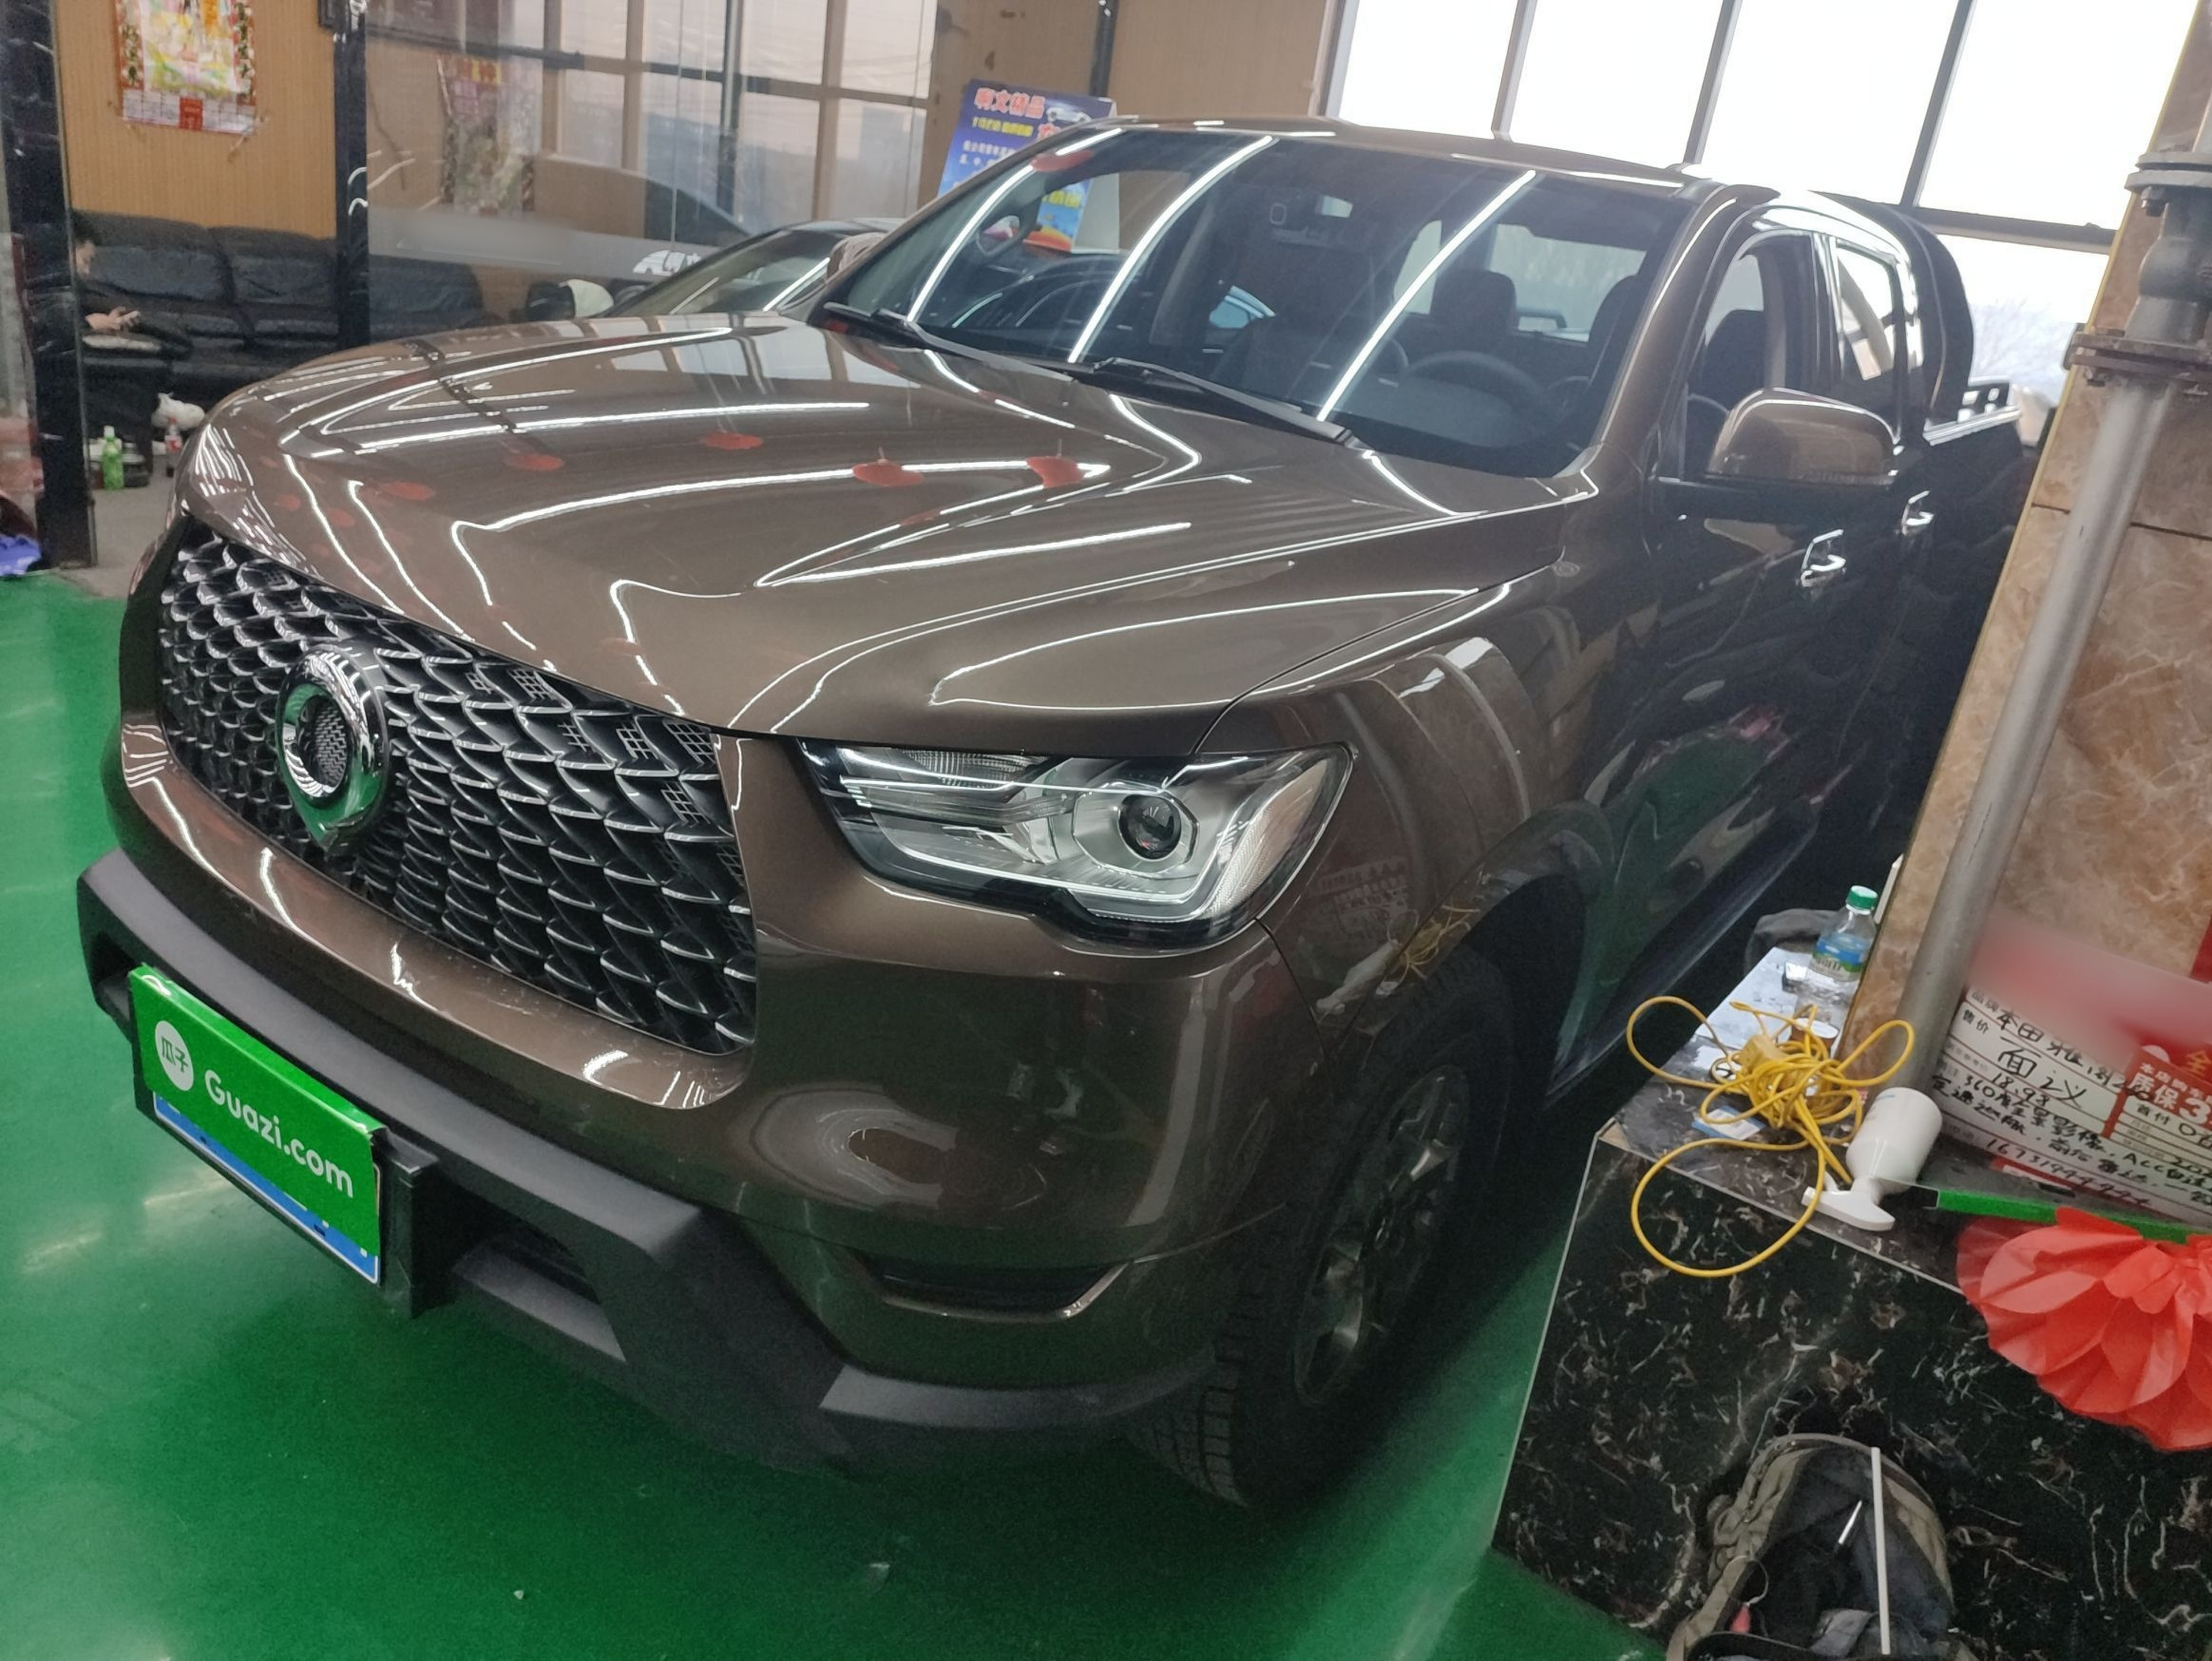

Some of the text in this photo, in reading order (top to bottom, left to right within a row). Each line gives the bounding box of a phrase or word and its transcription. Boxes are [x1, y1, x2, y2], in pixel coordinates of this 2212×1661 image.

[1963, 1009, 1989, 1034] 售价
[161, 1037, 189, 1073] 瓜子
[1998, 1036, 2088, 1109] 面议
[2128, 1072, 2212, 1126] 质保3
[204, 1069, 354, 1198] Guazi.com
